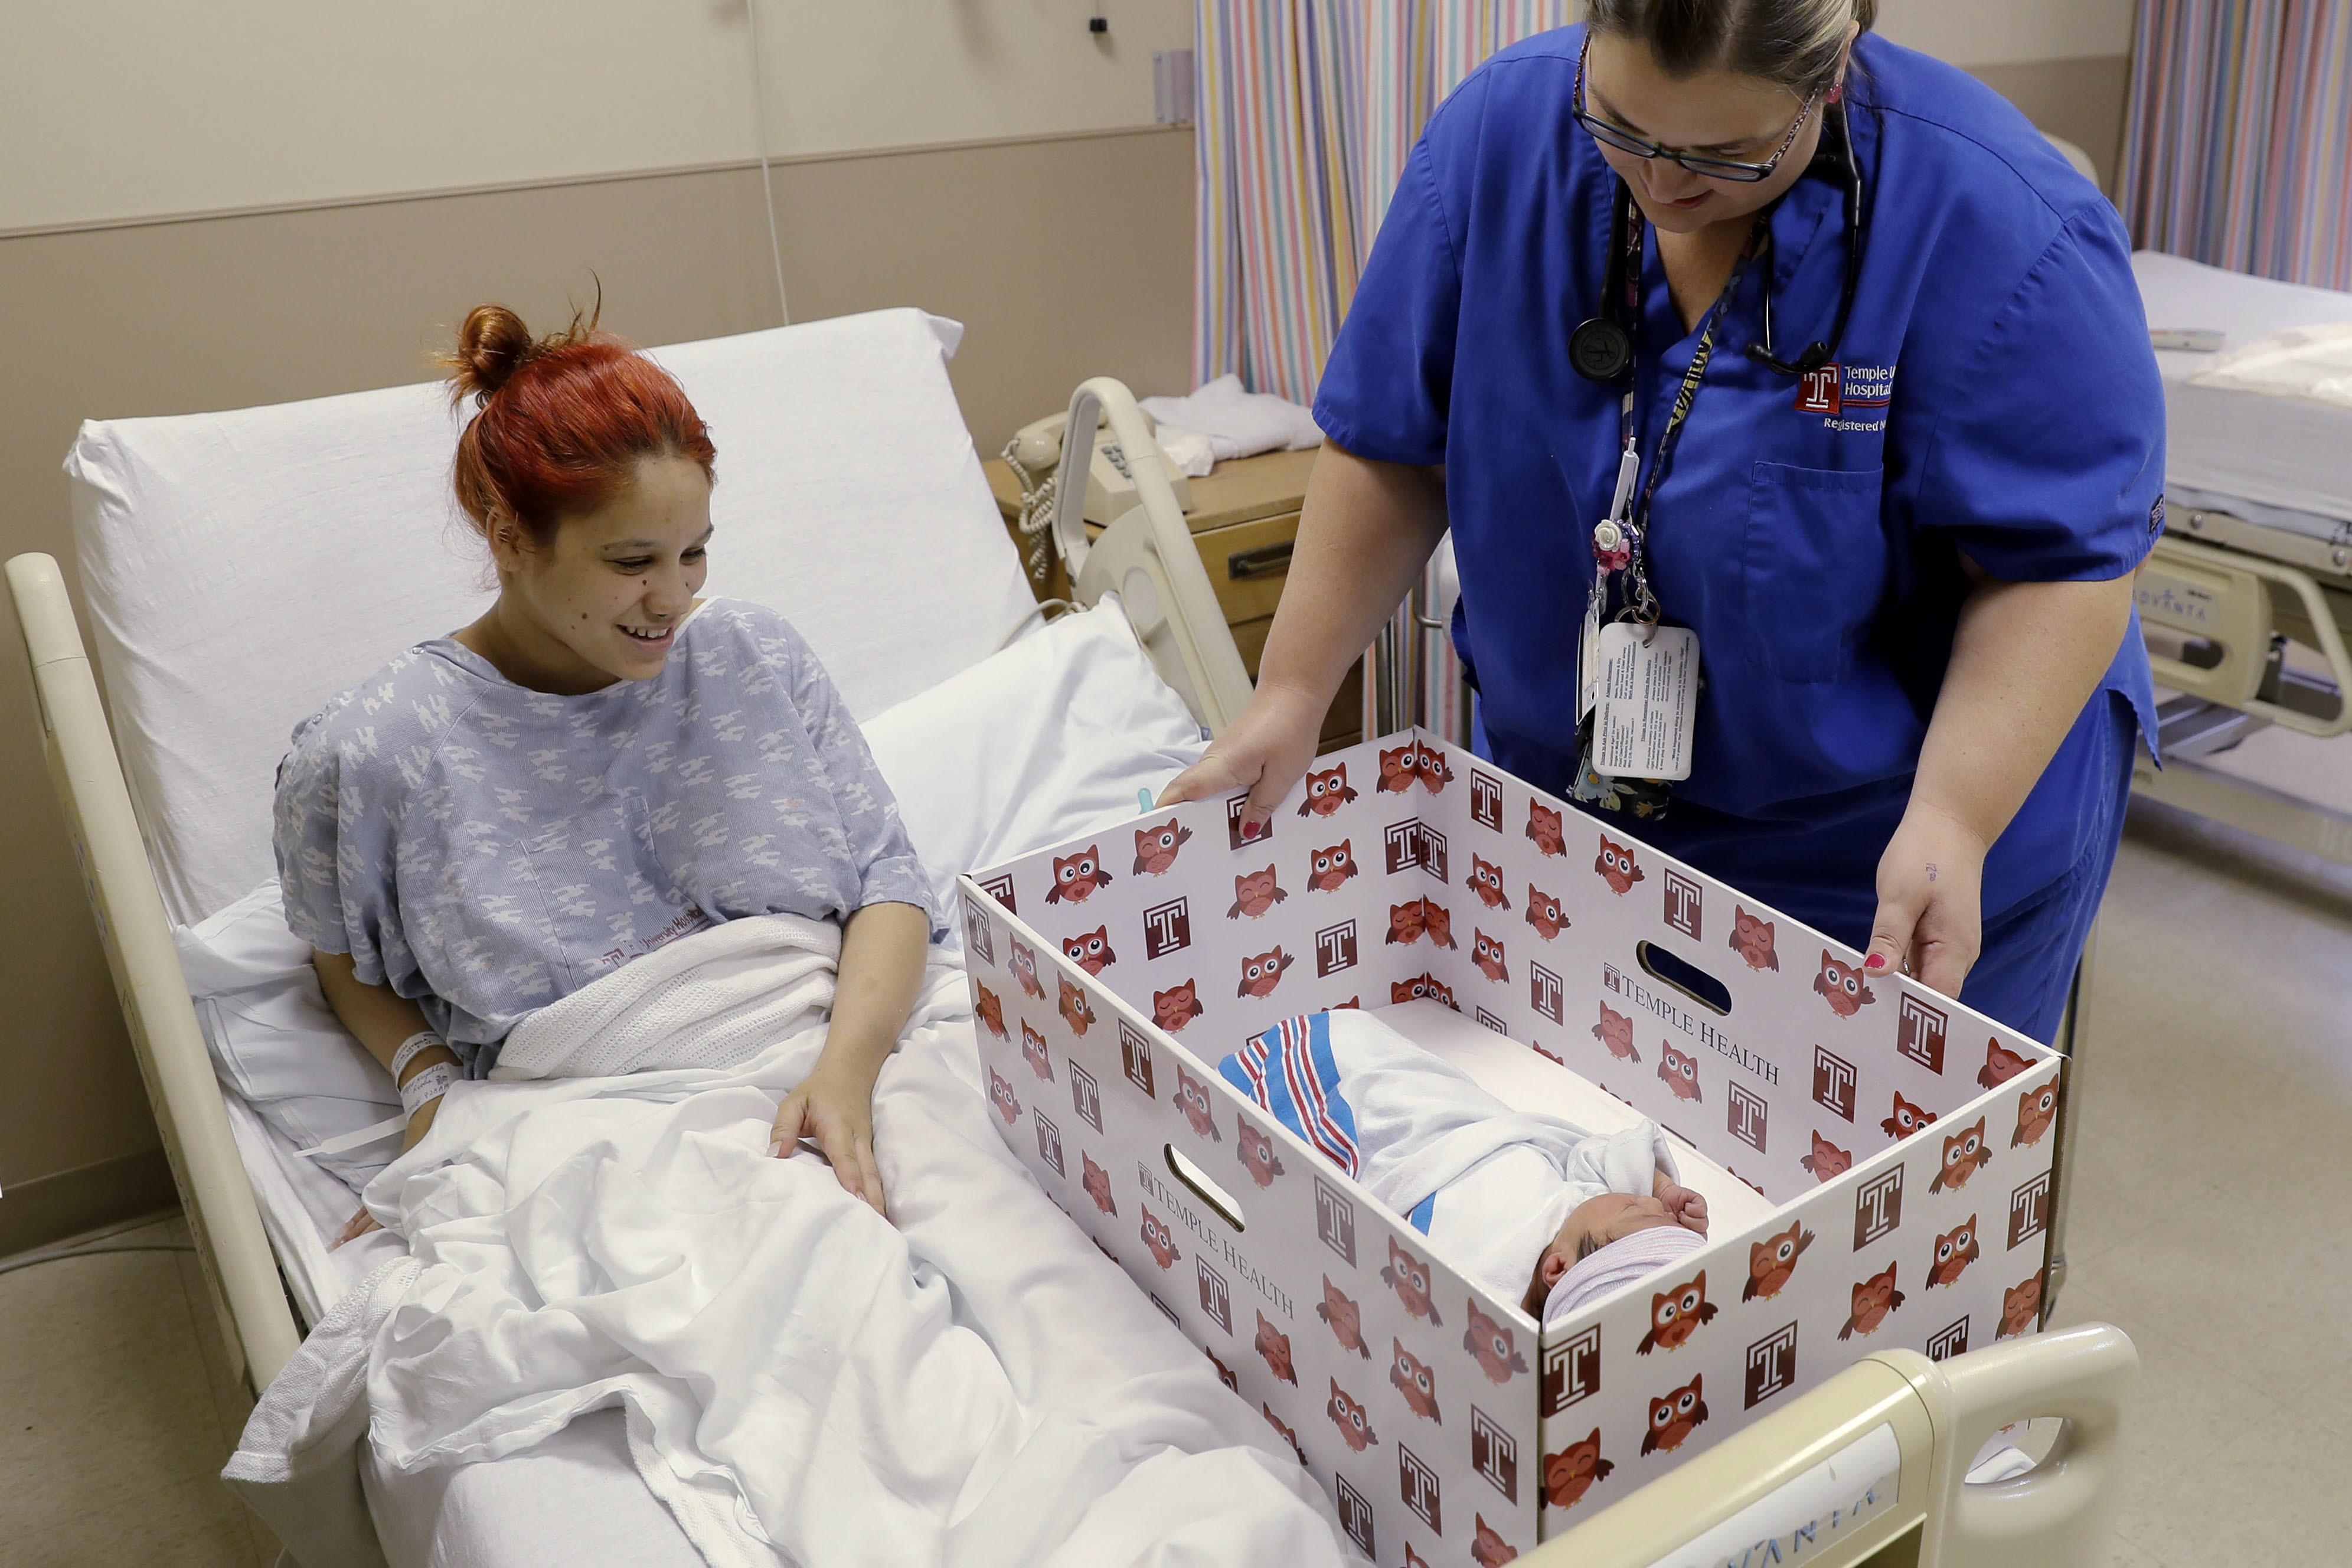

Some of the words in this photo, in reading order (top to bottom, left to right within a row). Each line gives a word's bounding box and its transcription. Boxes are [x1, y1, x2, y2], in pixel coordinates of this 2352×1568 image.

[1844, 365, 1888, 382] Temple
[1845, 381, 1893, 398] Hospital
[1824, 418, 1879, 432] Registered
[1472, 769, 1501, 829] T
[1384, 817, 1418, 874] T
[1419, 822, 1448, 884] T
[968, 899, 993, 962] T
[1146, 898, 1188, 955] T
[1666, 870, 1701, 937] T
[1317, 920, 1356, 974] T
[1531, 962, 1562, 1022] T
[1605, 963, 1619, 992] T
[1622, 975, 1694, 1036] TEMPLE
[1700, 1021, 1779, 1087] HEALTH
[1120, 1020, 1154, 1094] T
[1899, 994, 1946, 1070] T
[1070, 1061, 1102, 1130] T
[1729, 1082, 1767, 1149] T
[1815, 1047, 1855, 1118] T
[1035, 1108, 1064, 1174] T
[1317, 1177, 1355, 1263] T
[1855, 1165, 1902, 1246] T
[2008, 1172, 2049, 1246] T
[1154, 1177, 1219, 1253] TEMPLE
[1223, 1243, 1293, 1320] HEALTH
[1197, 1255, 1231, 1331] T
[1544, 1326, 1598, 1412] T
[1747, 1322, 1795, 1404] T
[1400, 1444, 1440, 1531] T
[1473, 1406, 1515, 1499] T
[1337, 1474, 1374, 1556] T
